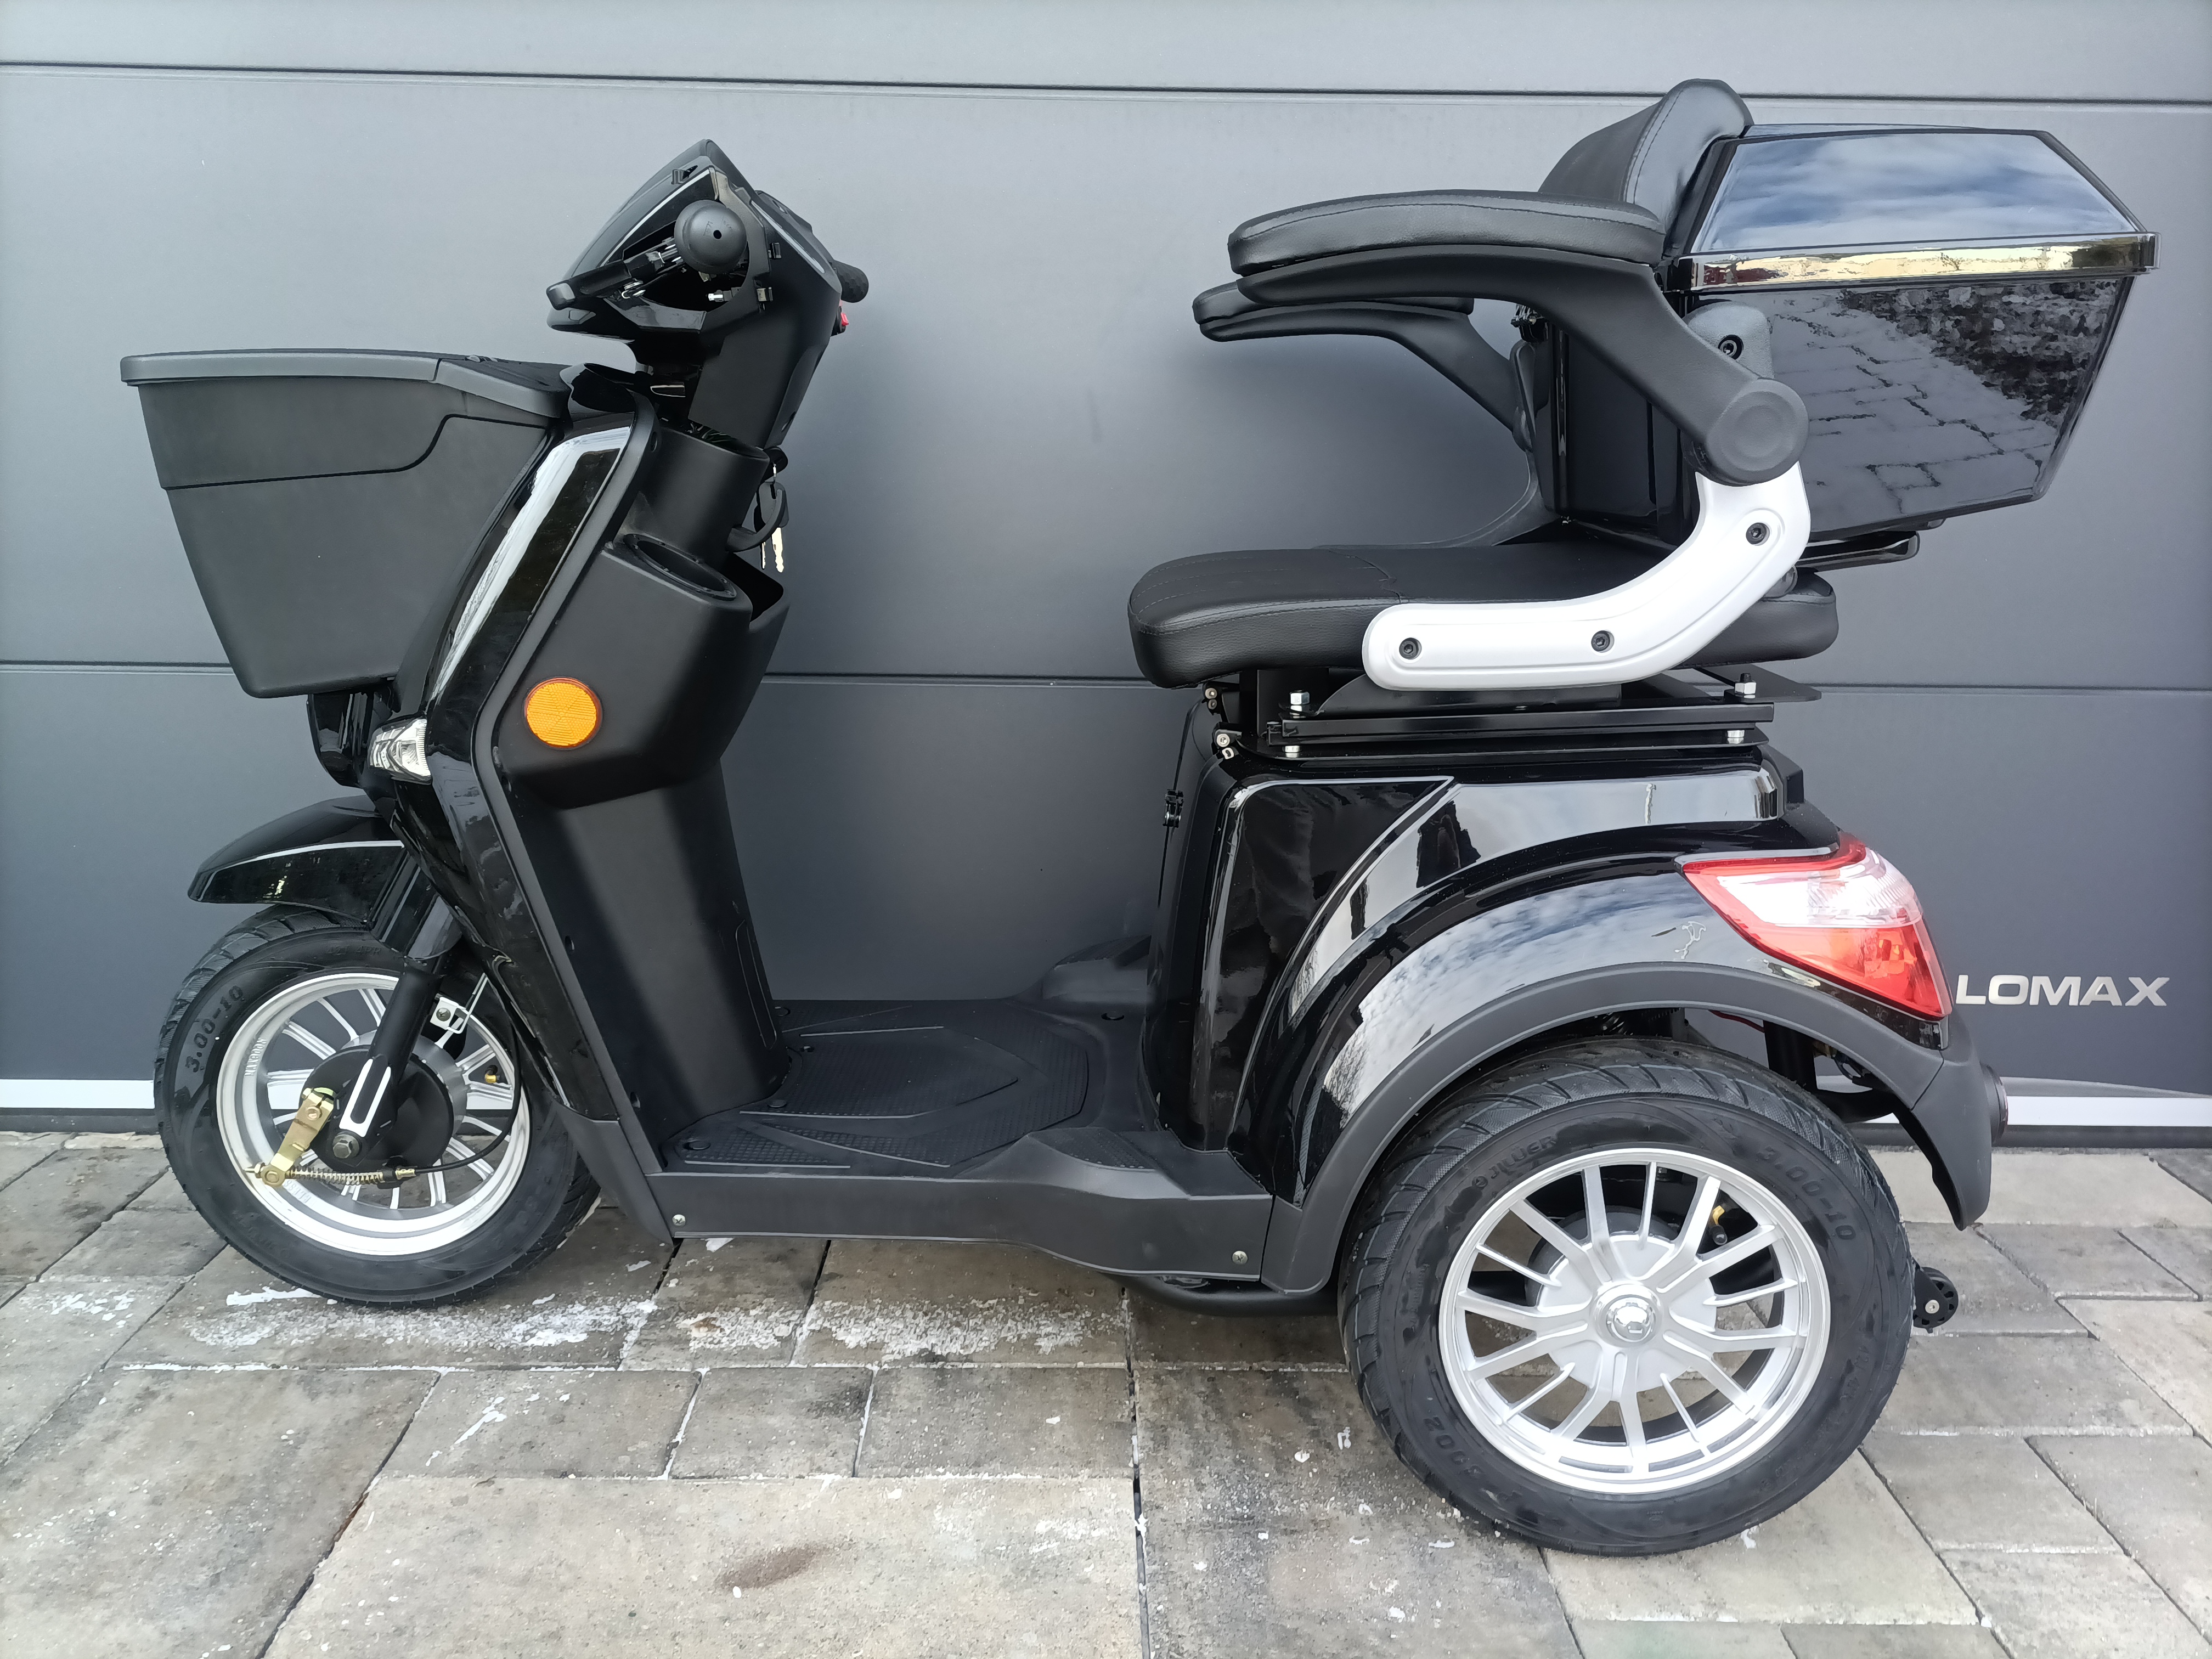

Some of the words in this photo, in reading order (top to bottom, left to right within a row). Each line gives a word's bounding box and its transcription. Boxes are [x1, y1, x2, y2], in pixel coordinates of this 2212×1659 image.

[184, 985, 243, 1073] 3.00-10
[1955, 974, 2170, 1006] LOMAX
[1756, 1146, 1857, 1240] 3.00-10
